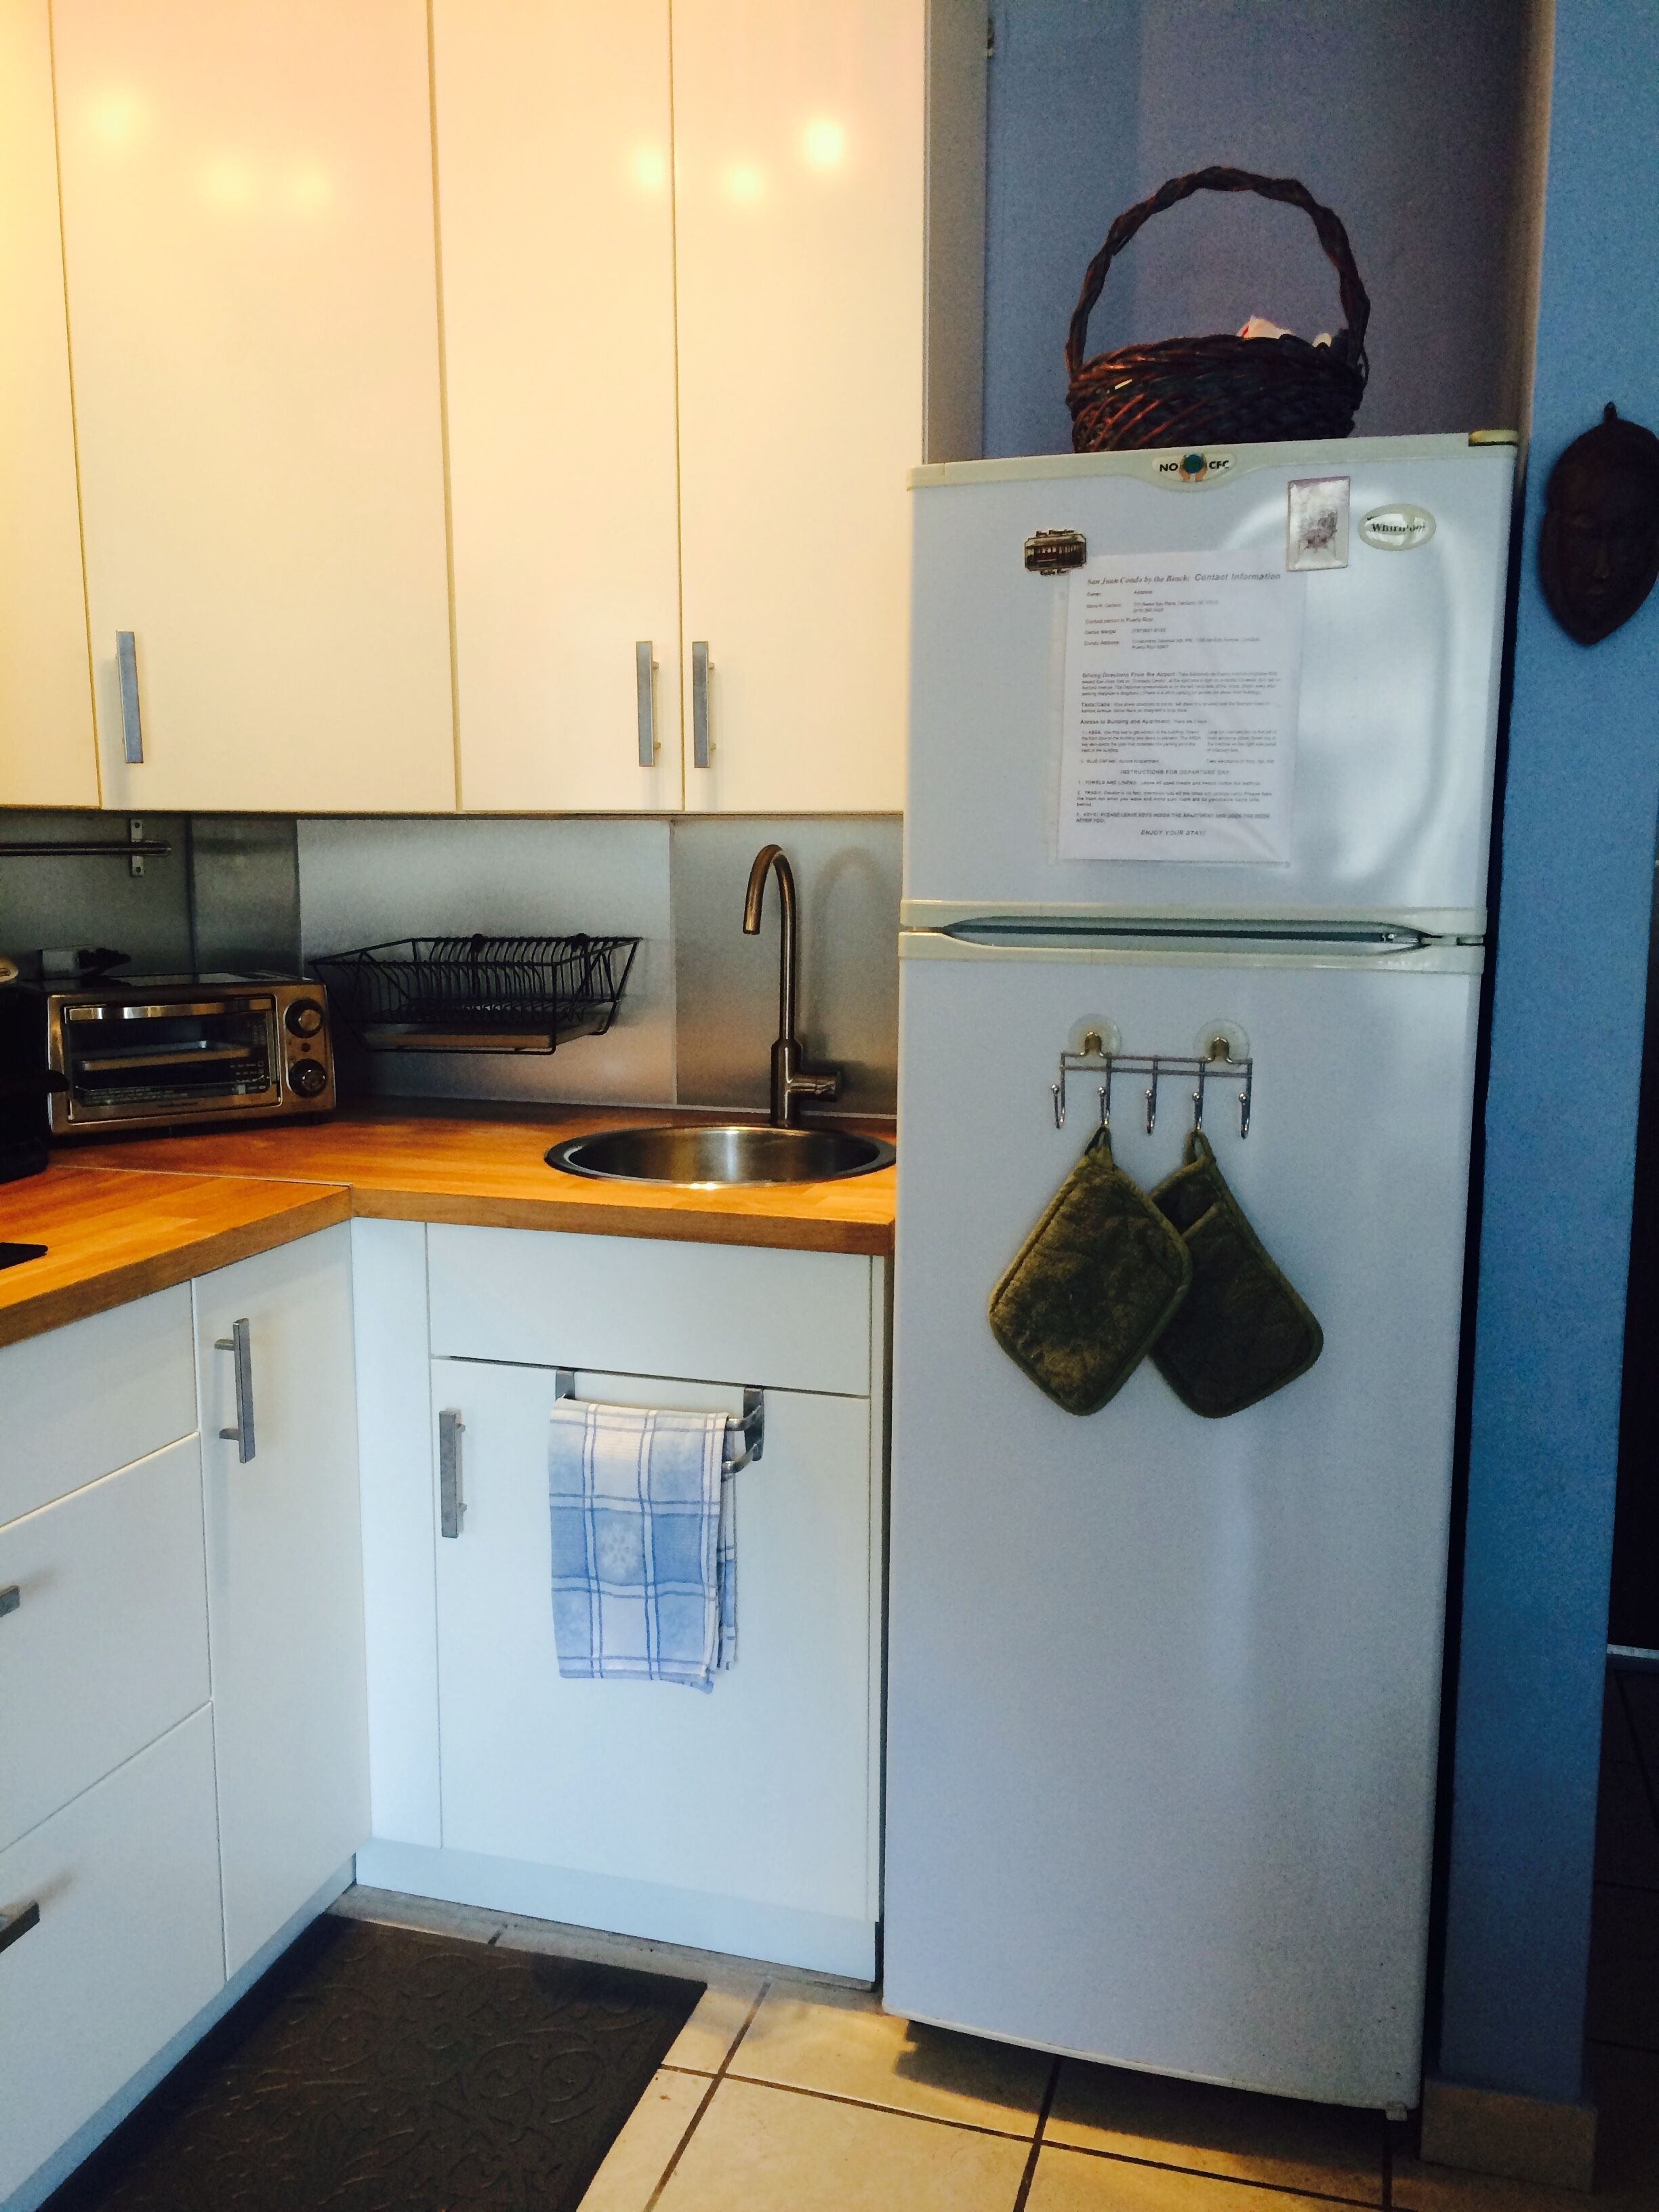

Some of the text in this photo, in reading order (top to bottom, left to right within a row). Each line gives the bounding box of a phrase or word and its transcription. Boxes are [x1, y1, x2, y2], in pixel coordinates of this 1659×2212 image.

[1160, 460, 1229, 472] NO CFC
[1144, 575, 1152, 583] by
[1153, 575, 1165, 583] the
[1231, 573, 1281, 581] Information
